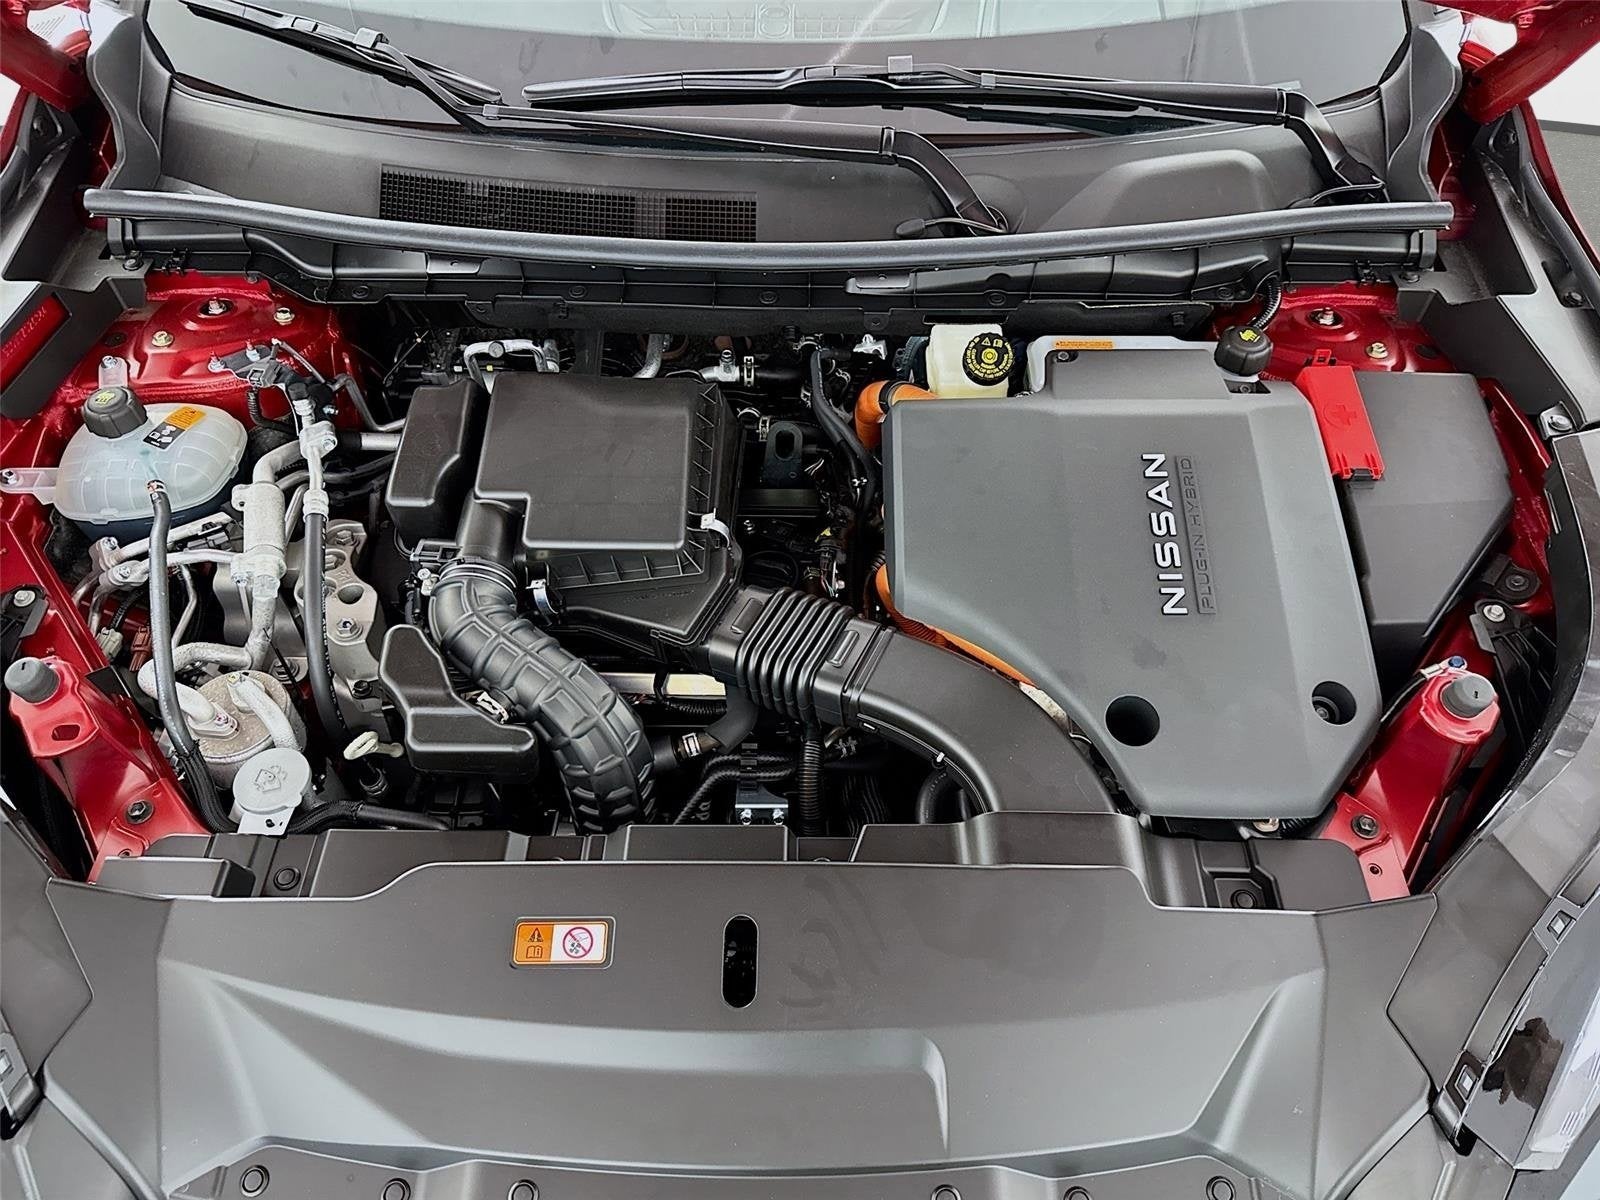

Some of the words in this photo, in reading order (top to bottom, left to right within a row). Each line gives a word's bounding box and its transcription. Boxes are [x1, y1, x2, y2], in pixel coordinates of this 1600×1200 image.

[1180, 458, 1202, 527] HYBRID
[1141, 453, 1188, 615] NISSAN
[1192, 534, 1214, 609] PLUG-IN
